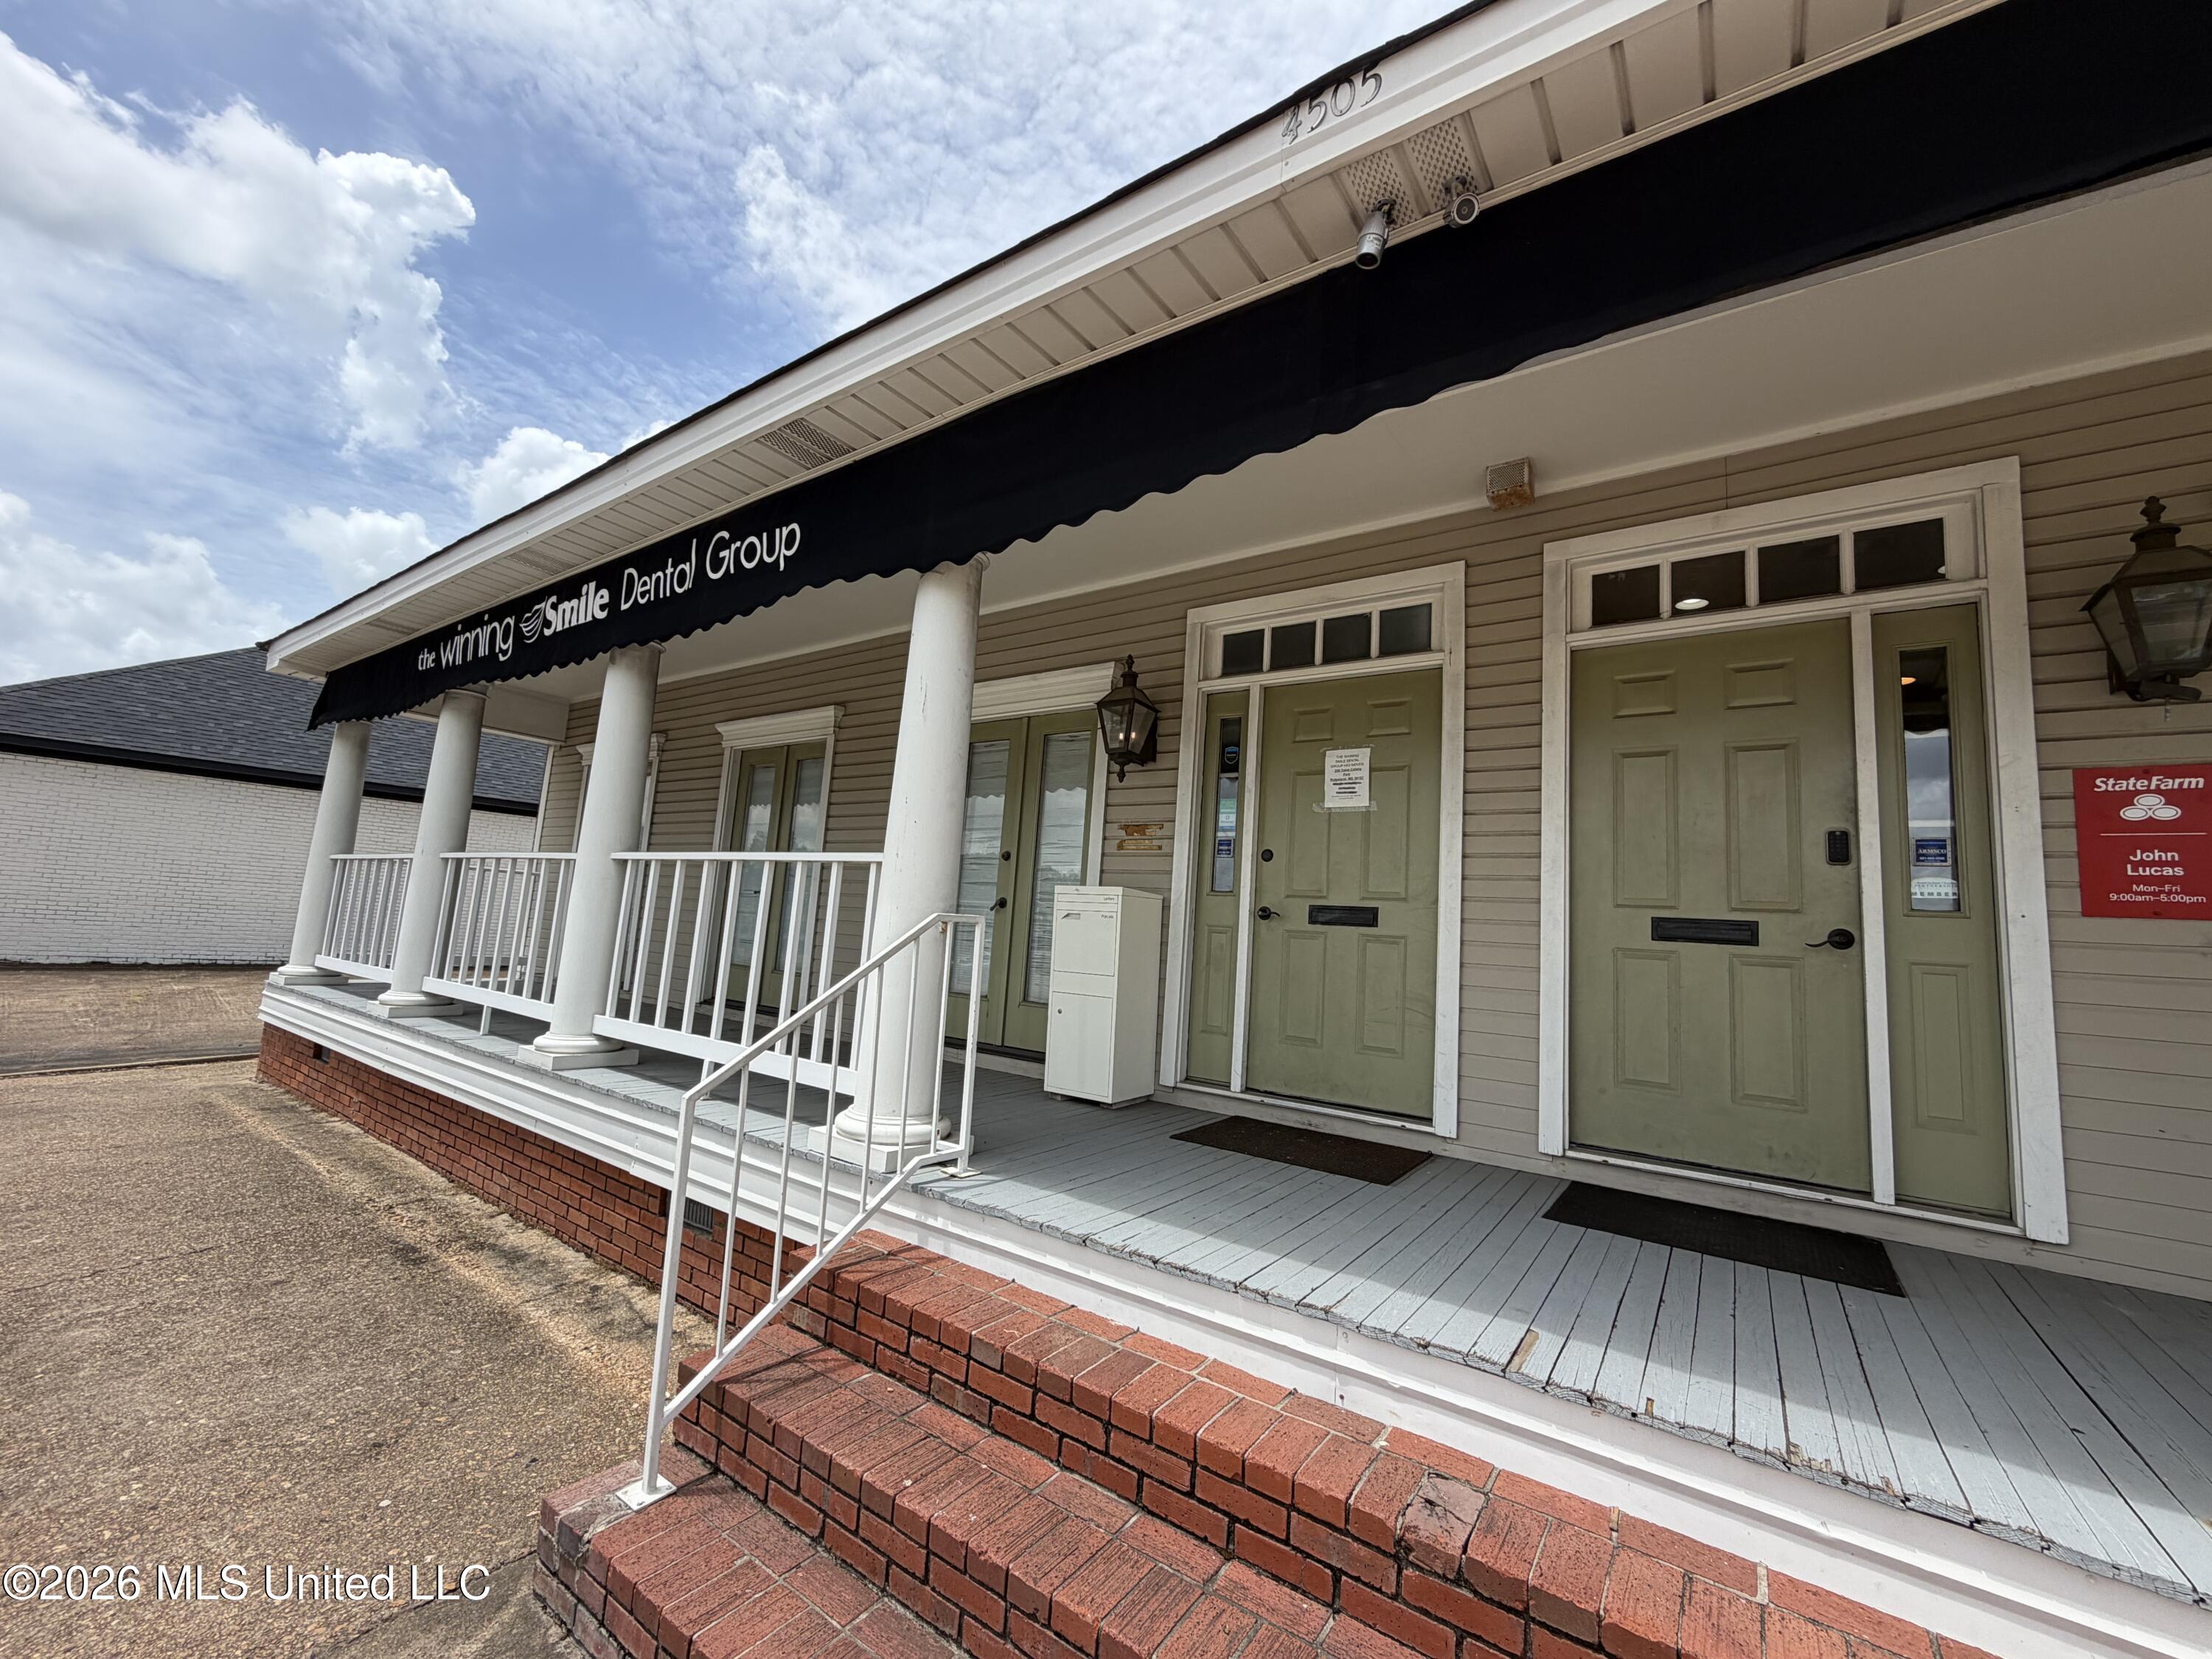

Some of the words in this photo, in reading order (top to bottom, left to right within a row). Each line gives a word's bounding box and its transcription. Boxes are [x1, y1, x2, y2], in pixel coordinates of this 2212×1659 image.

[1281, 65, 1382, 145] 4505
[418, 648, 436, 670] the
[440, 613, 515, 669] winning
[543, 580, 610, 636] Smile
[620, 538, 697, 611] Dental
[706, 523, 801, 579] Group
[2126, 863, 2184, 876] Lucas
[2129, 849, 2179, 861] John
